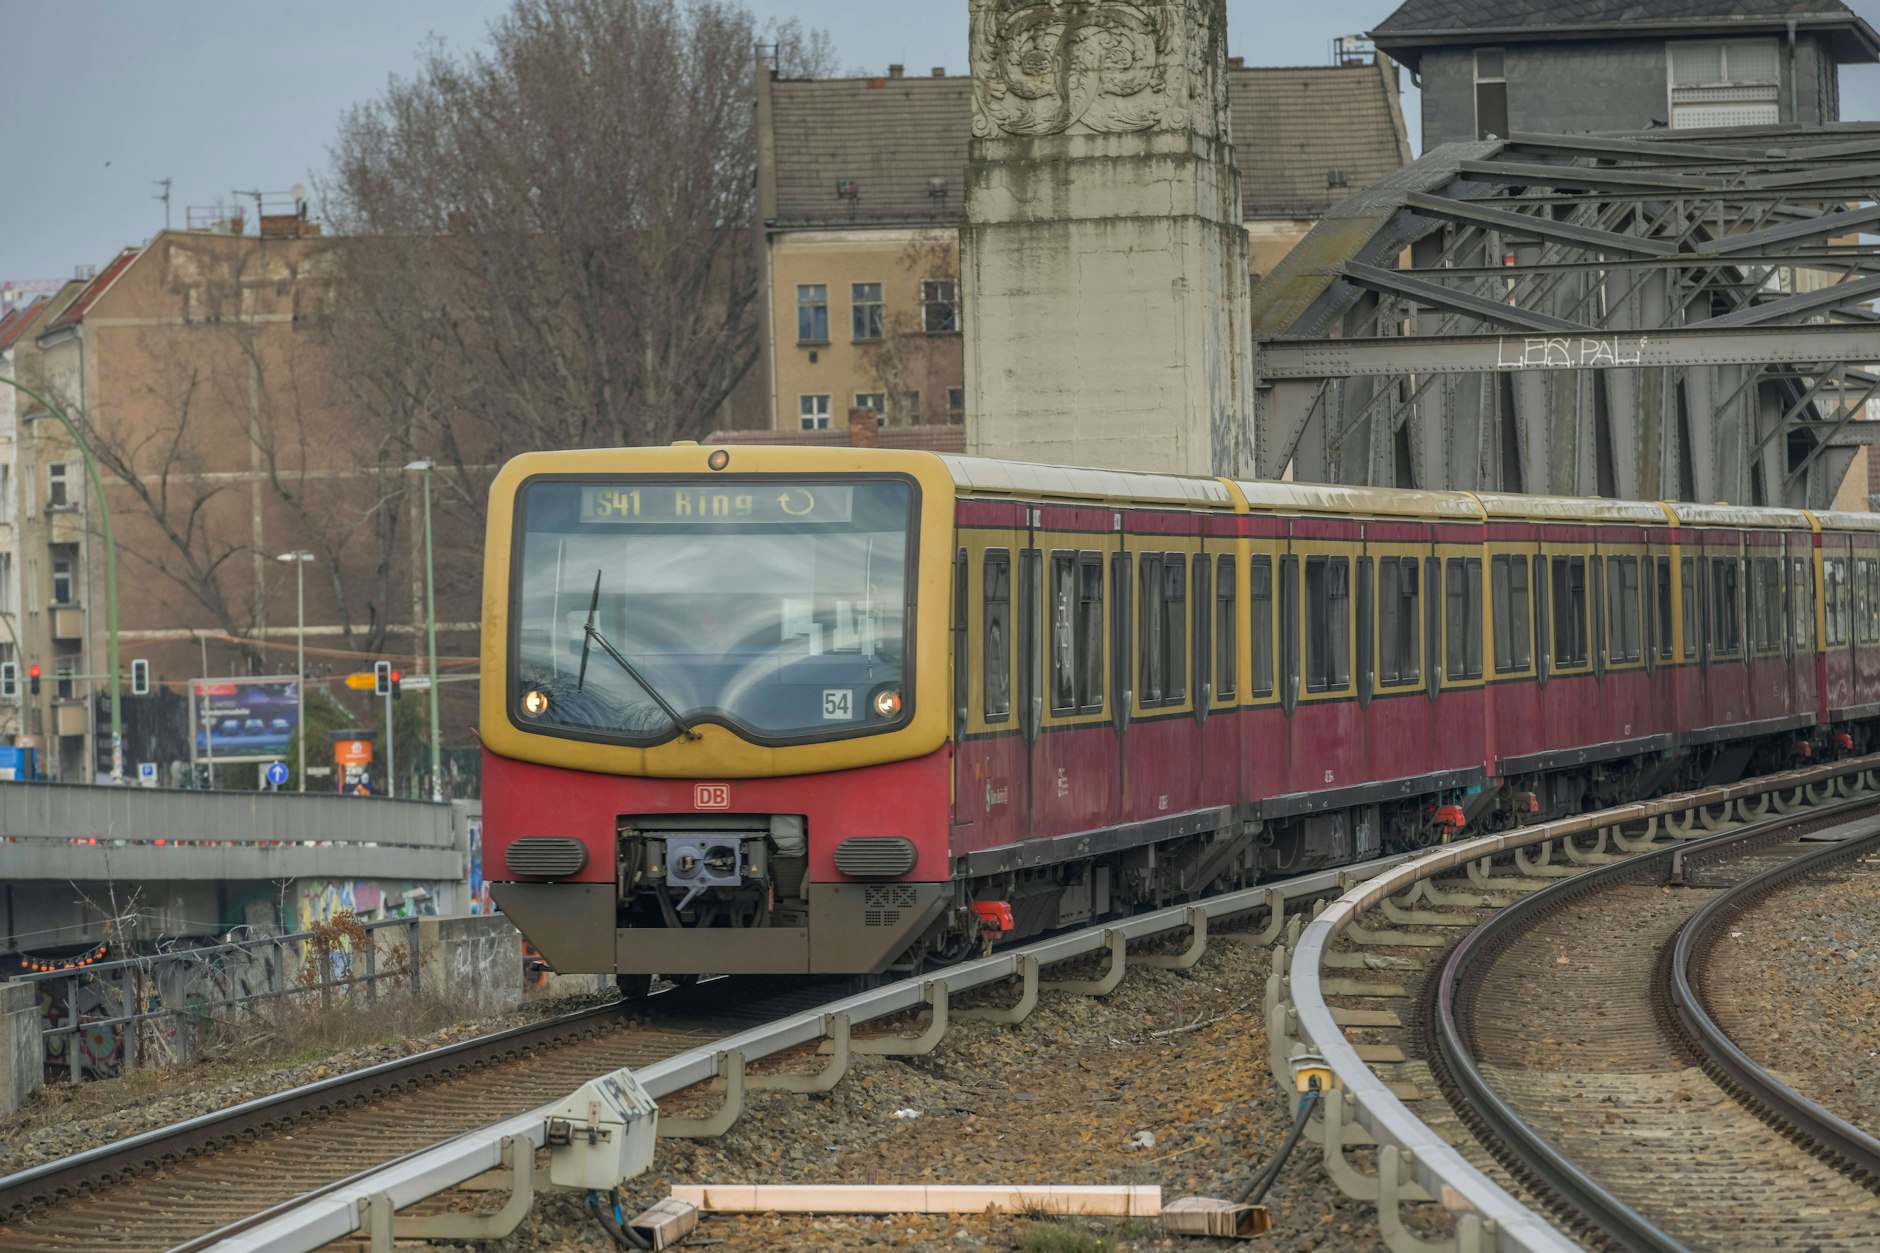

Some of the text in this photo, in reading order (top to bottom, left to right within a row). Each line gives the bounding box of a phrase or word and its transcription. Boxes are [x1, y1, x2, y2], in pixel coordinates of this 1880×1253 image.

[596, 489, 753, 516] S41 Ring
[825, 693, 849, 714] 54
[700, 788, 725, 805] DB
